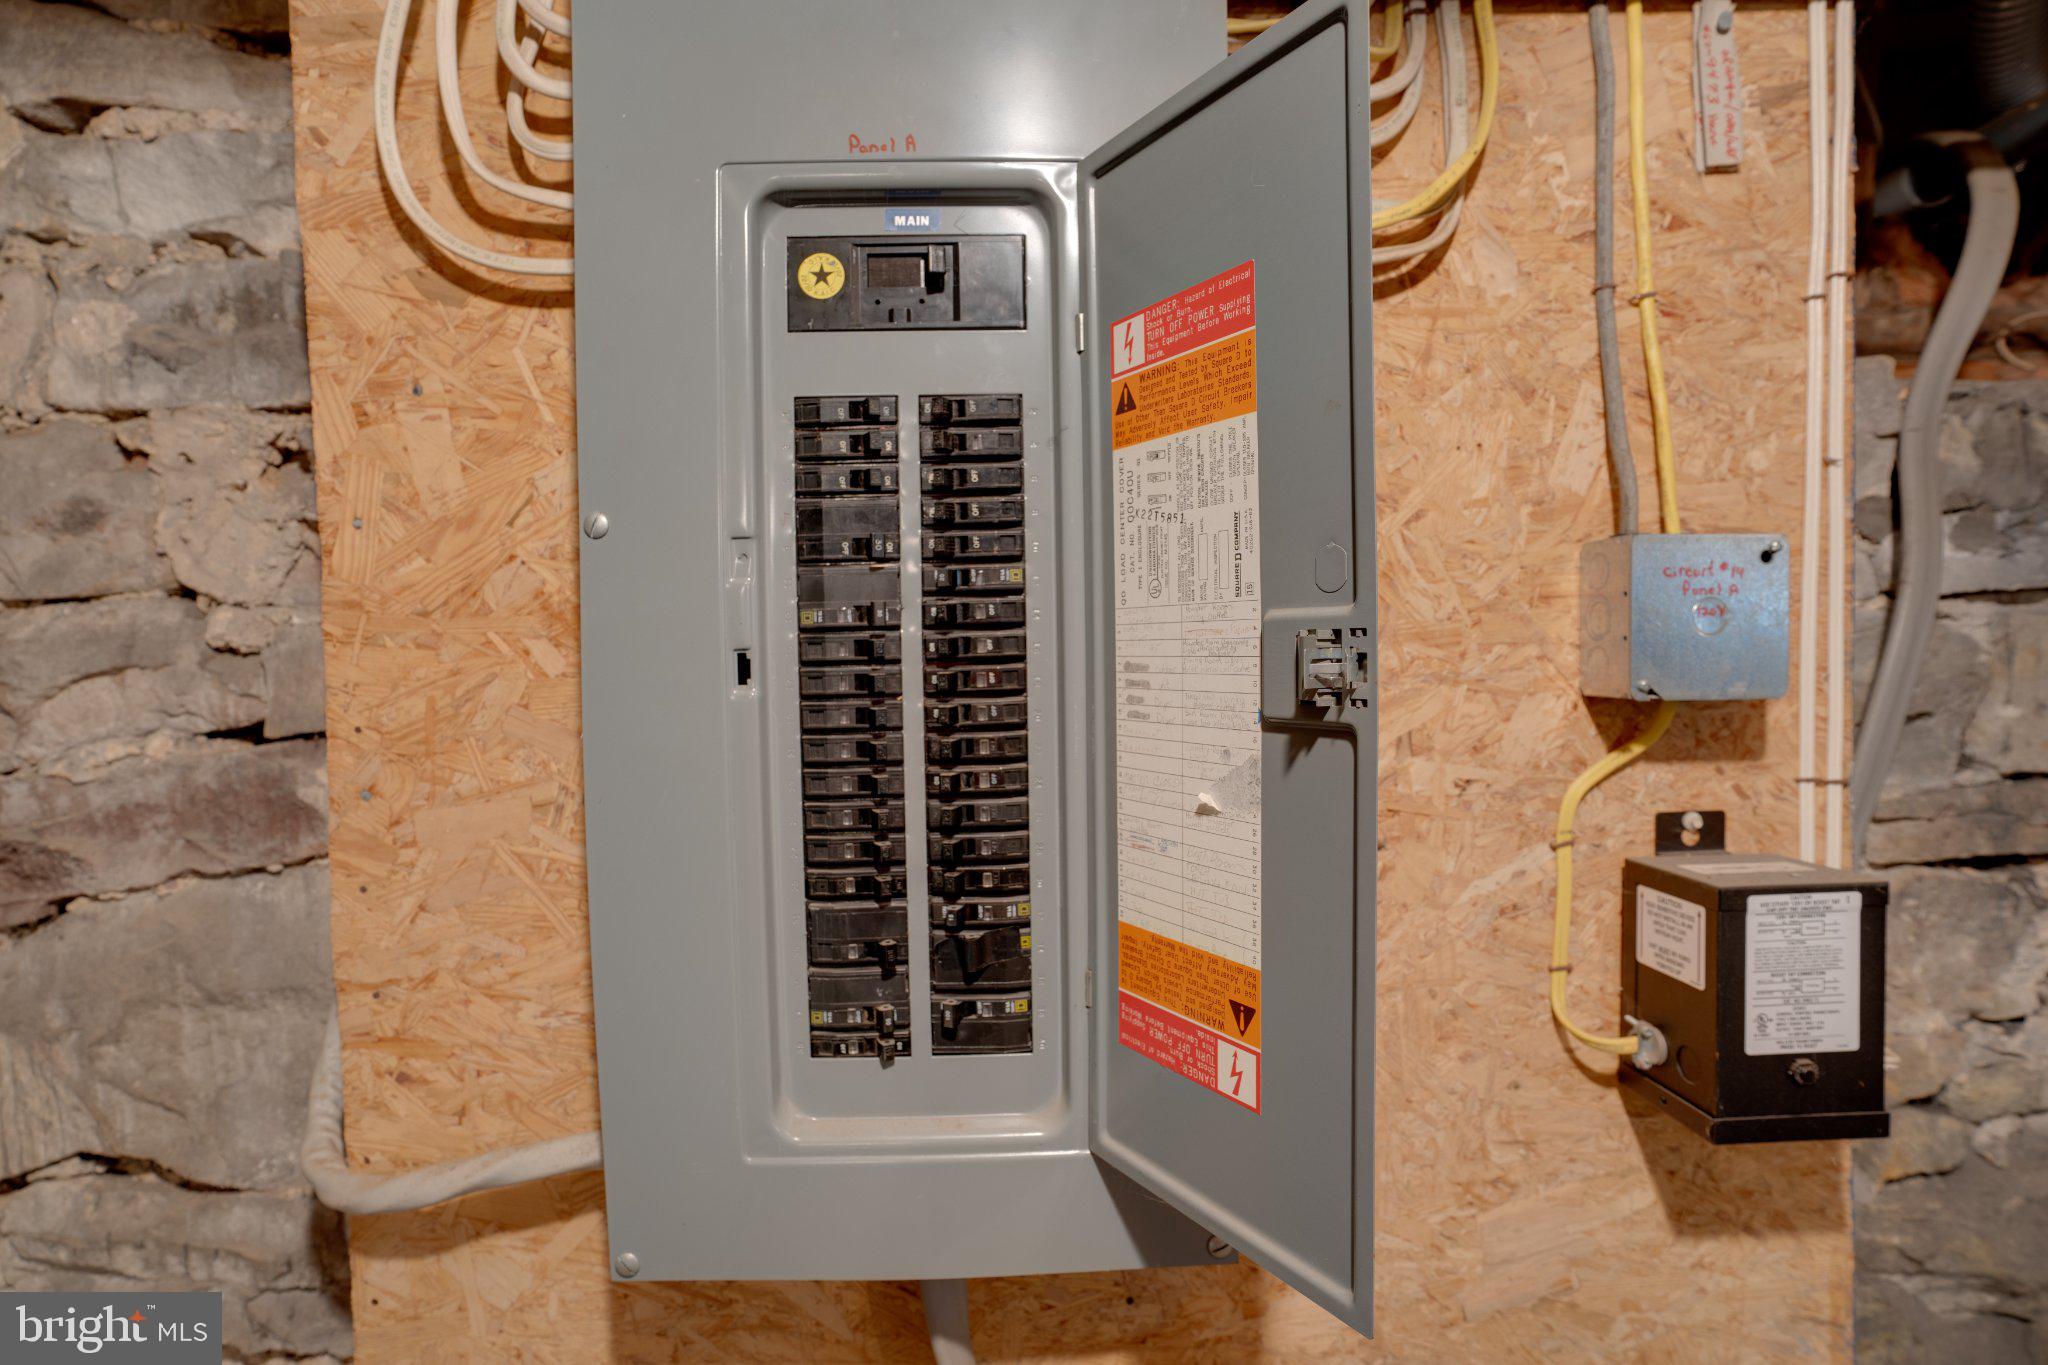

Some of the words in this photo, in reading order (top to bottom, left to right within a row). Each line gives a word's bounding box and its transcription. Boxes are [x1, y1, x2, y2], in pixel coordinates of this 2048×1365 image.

[849, 133, 895, 153] Panel
[906, 134, 917, 151] A
[895, 215, 930, 226] MAIN
[1146, 299, 1180, 321] DANGER:
[1184, 290, 1205, 304] Hazard
[1209, 285, 1215, 294] of
[1219, 269, 1250, 289] Electrical
[1147, 326, 1164, 341] TURN
[1170, 319, 1182, 333] OFF
[1189, 306, 1214, 325] POWER
[1219, 294, 1250, 312] Supplying
[1162, 328, 1193, 345] Equipment
[1198, 318, 1219, 331] Before
[1223, 305, 1250, 320] Working
[1140, 362, 1180, 382] WARNING:
[1203, 342, 1239, 361] Equipment
[1227, 359, 1251, 373] Exceed
[1178, 383, 1214, 400] Laboratories
[1199, 390, 1220, 403] Circuit
[1224, 381, 1251, 395] Breakers
[924, 403, 931, 413] ON
[885, 441, 892, 451] ON
[885, 476, 891, 485] ON
[886, 542, 893, 552] ON
[1682, 580, 1722, 596] Panel
[1728, 584, 1739, 596] A
[1120, 591, 1126, 606] QO
[1182, 1005, 1225, 1030] WARNING:
[1149, 1026, 1173, 1046] POWER
[1178, 1040, 1190, 1054] OFF
[1195, 1048, 1215, 1066] TURN
[1181, 1062, 1216, 1088] DANGER:
